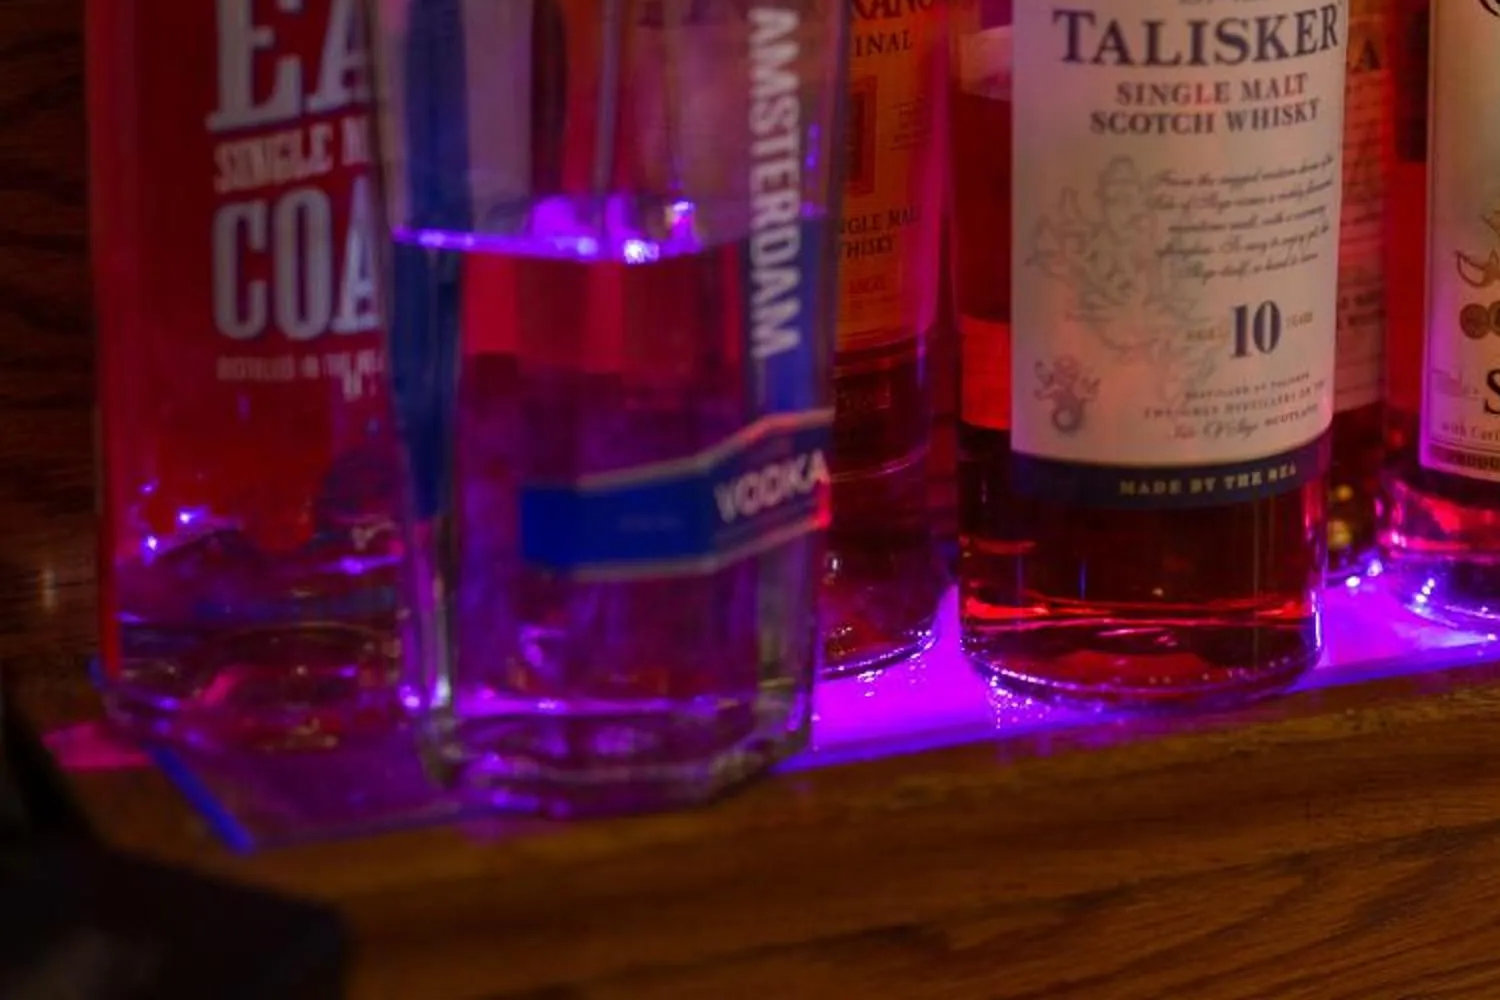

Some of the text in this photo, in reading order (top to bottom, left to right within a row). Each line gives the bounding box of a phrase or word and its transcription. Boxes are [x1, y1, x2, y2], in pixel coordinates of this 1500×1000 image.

[1051, 2, 1341, 66] TALISKER
[1089, 98, 1321, 136] SCOTCH WHISKY
[1115, 72, 1309, 107] SINGLE MALT
[213, 123, 335, 194] SINGLE
[748, 7, 799, 359] AMSTERDAM
[1229, 300, 1283, 359] 10
[713, 448, 831, 524] VODKA
[1119, 463, 1298, 496] MADE BY THE SEA
